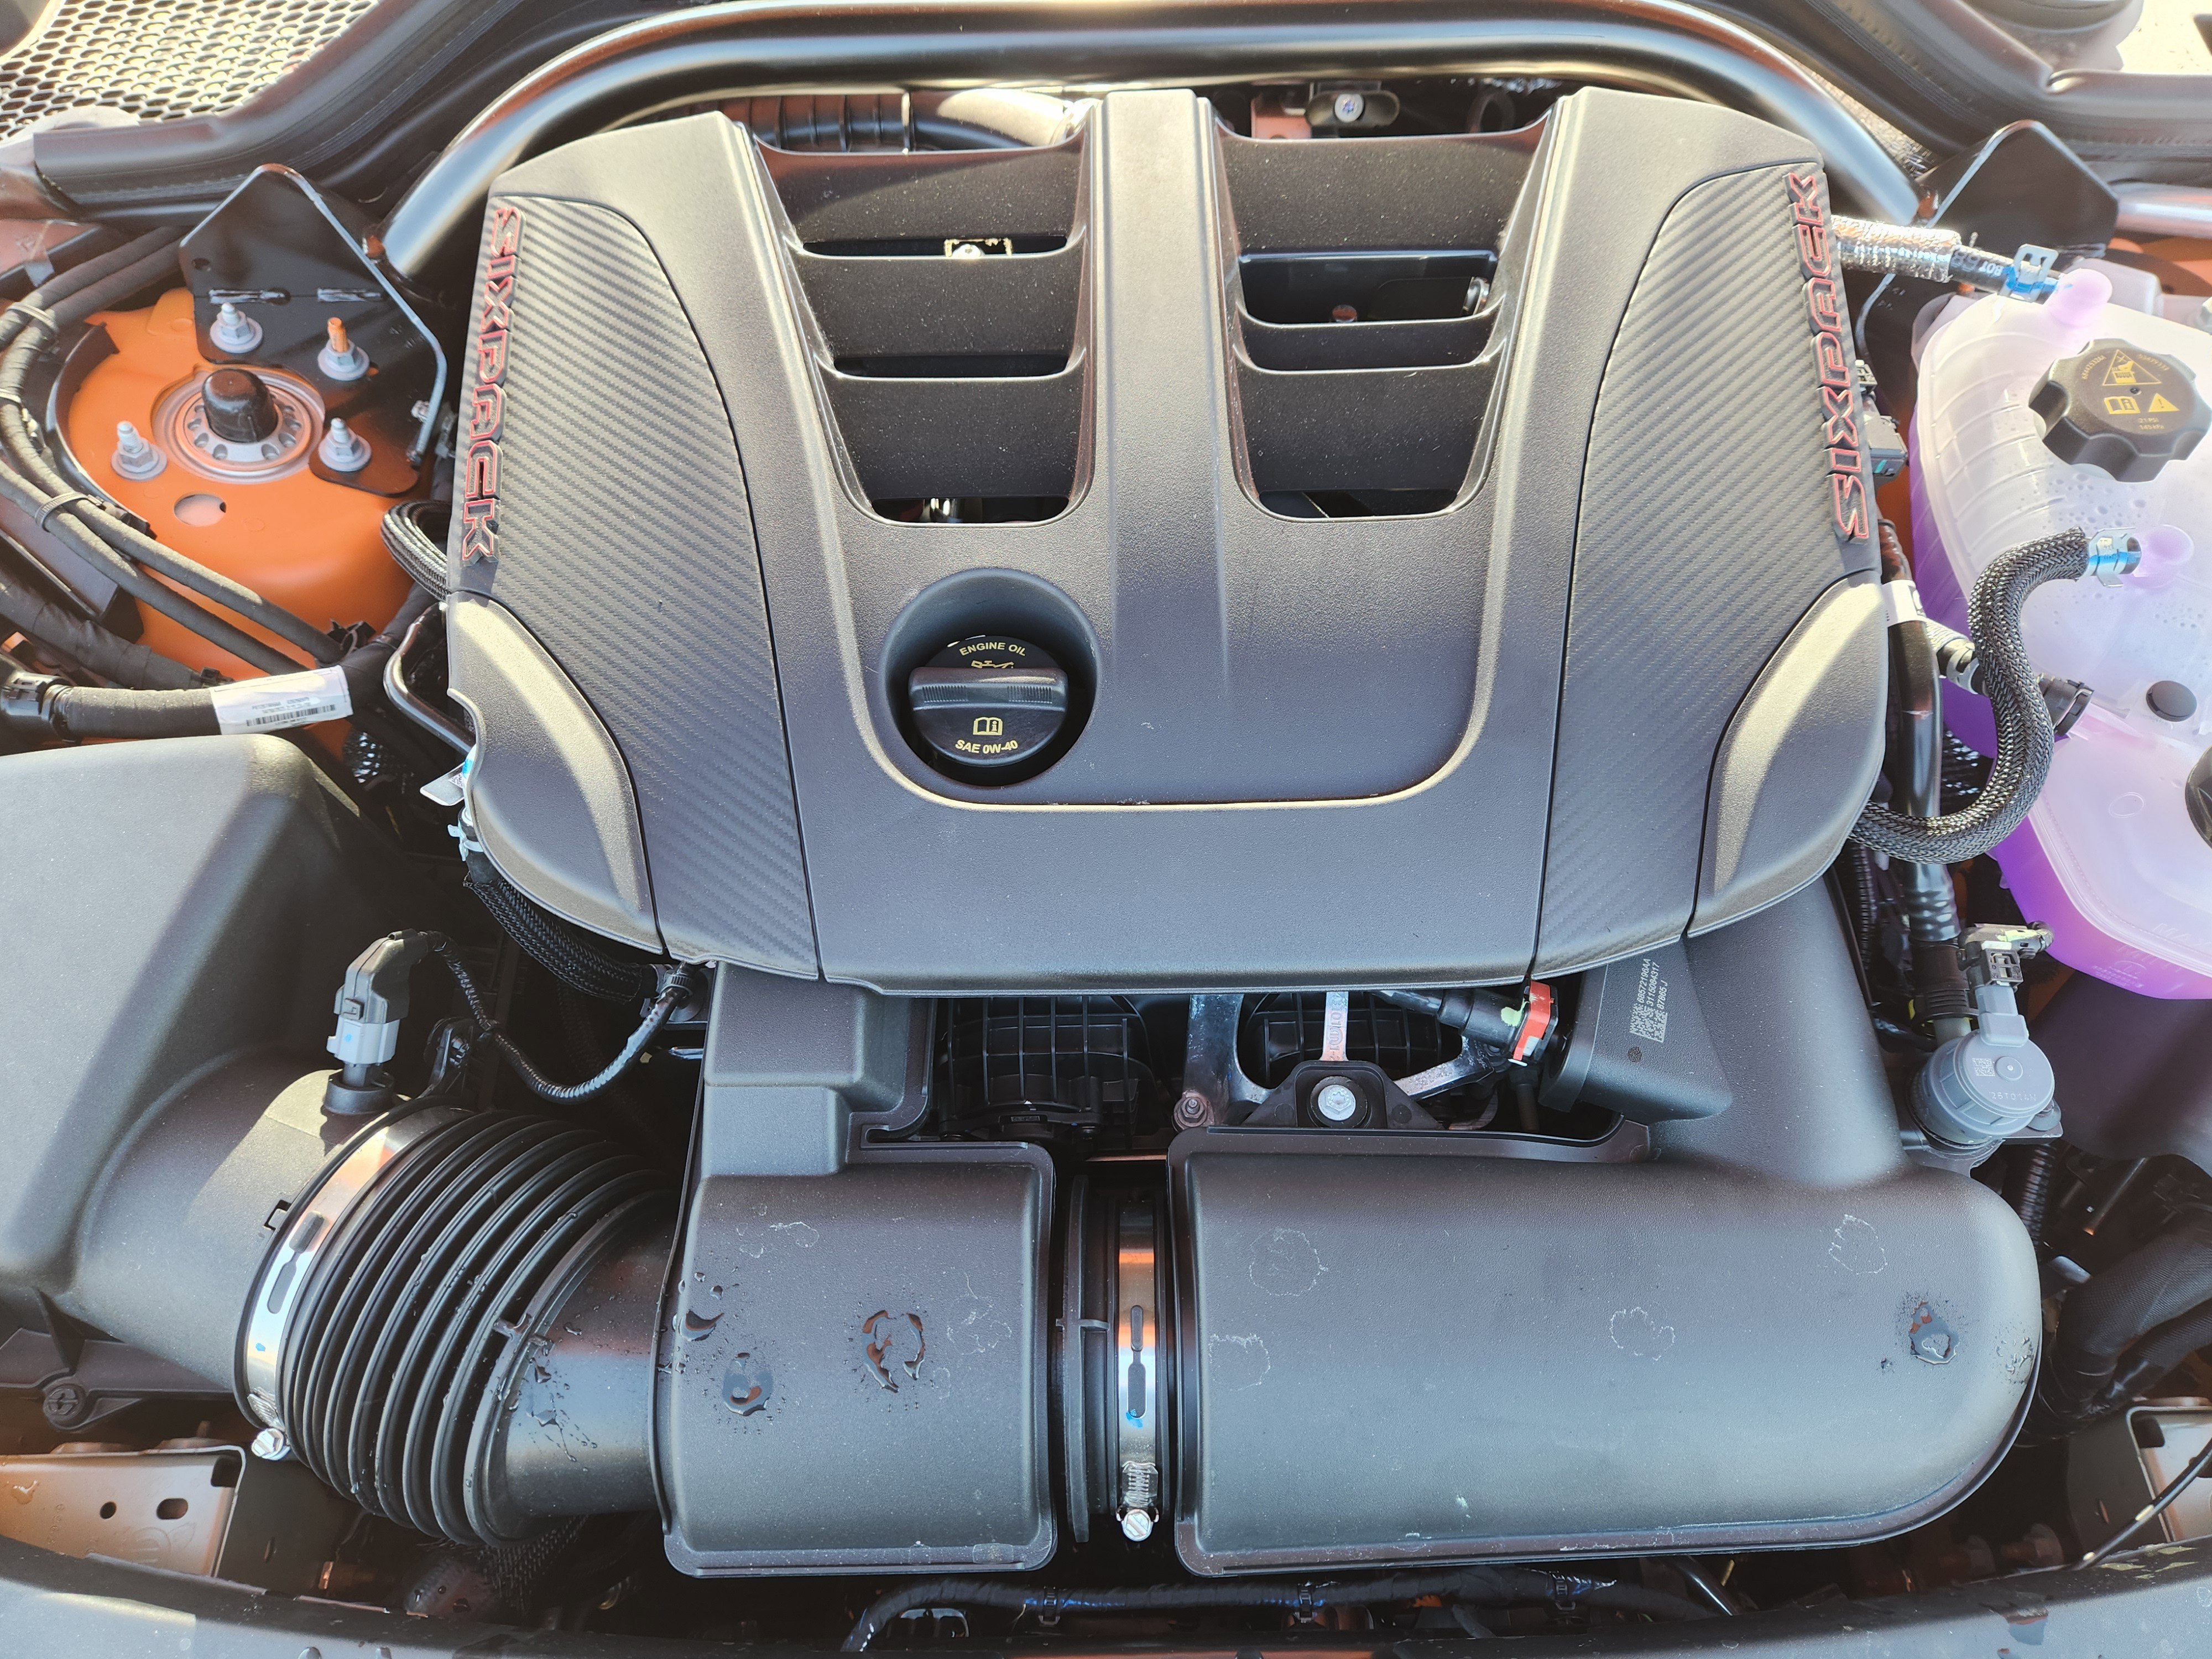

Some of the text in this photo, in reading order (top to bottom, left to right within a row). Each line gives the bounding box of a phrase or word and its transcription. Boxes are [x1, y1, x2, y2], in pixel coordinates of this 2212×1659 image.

[1786, 172, 1869, 540] SIXPACK
[462, 207, 524, 563] SIXPACK
[959, 641, 1026, 656] ENGINE OIL
[955, 739, 1018, 754] SAE 0W-40
[1637, 958, 1651, 1004] 68572196AA
[1646, 962, 1660, 1006] 3115084317
[1657, 987, 1667, 1009] 87865
